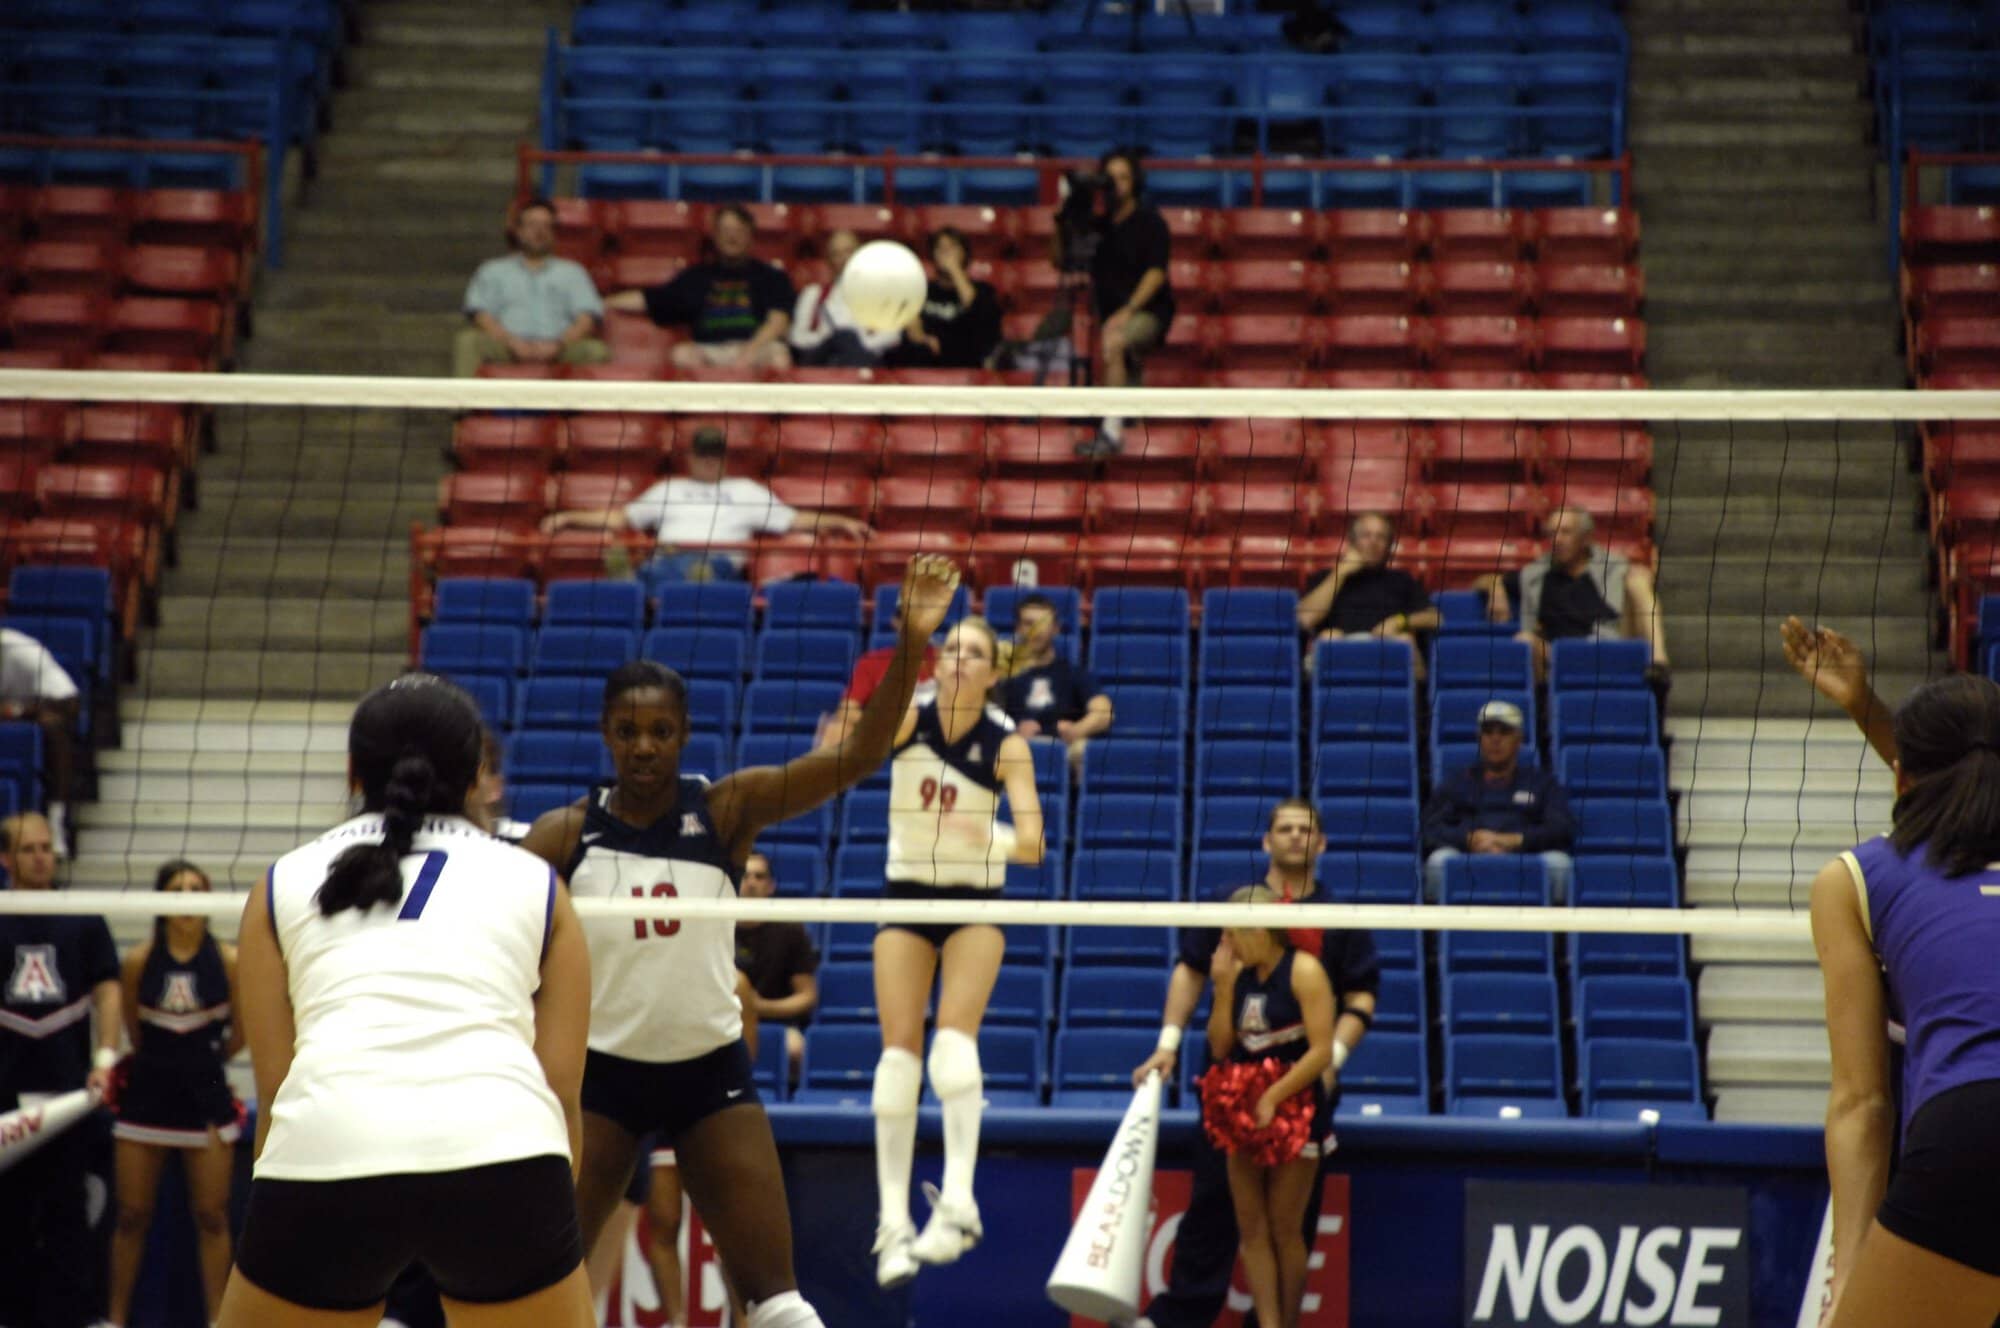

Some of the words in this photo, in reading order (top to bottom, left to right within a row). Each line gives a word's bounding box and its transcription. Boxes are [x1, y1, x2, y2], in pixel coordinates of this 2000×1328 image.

[919, 777, 957, 813] 99
[6, 945, 67, 1003] A
[1472, 1224, 1742, 1326] NOISE
